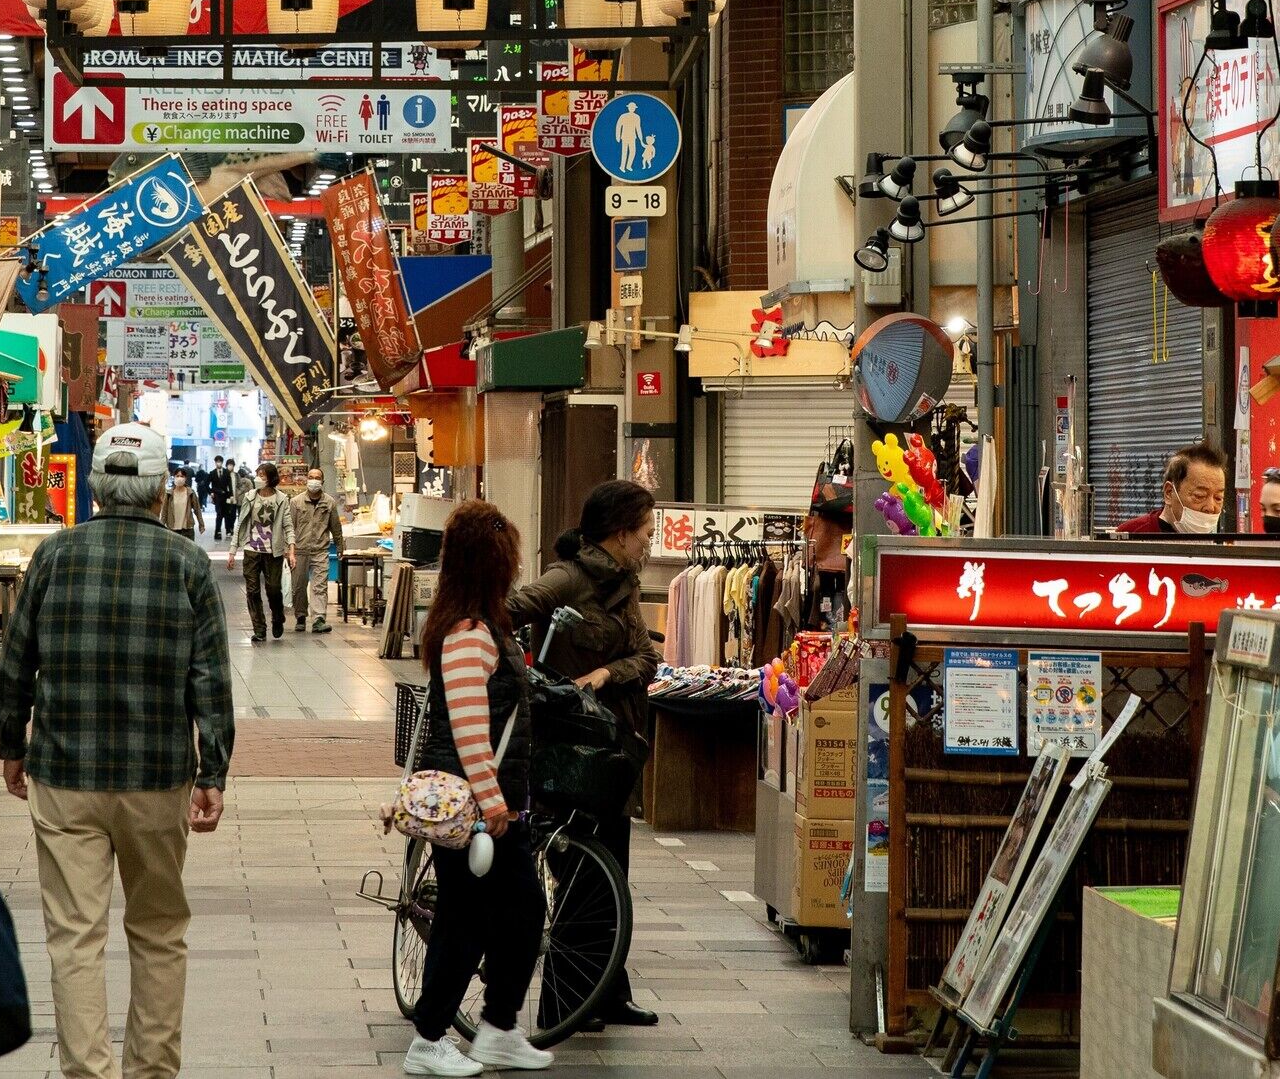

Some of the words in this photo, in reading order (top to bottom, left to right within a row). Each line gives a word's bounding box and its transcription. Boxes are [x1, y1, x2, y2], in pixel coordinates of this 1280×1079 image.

[142, 98, 182, 111] There
[187, 98, 197, 111] is
[201, 98, 247, 114] eating
[251, 100, 292, 114] space
[163, 112, 239, 120] 飲食スペースあります
[316, 114, 347, 127] FREE
[163, 125, 221, 143] Change
[225, 125, 290, 139] machine
[316, 129, 349, 143] Wi-Fi
[358, 134, 393, 144] TOILET
[471, 189, 514, 199] STAMP
[431, 221, 469, 229] STAMP
[132, 283, 157, 294] FREE
[159, 283, 180, 294] REST
[134, 294, 156, 302] There
[164, 294, 188, 304] eating
[217, 231, 312, 365] とらふぐ
[144, 307, 175, 318] Change
[1032, 570, 1177, 628] てっちり
